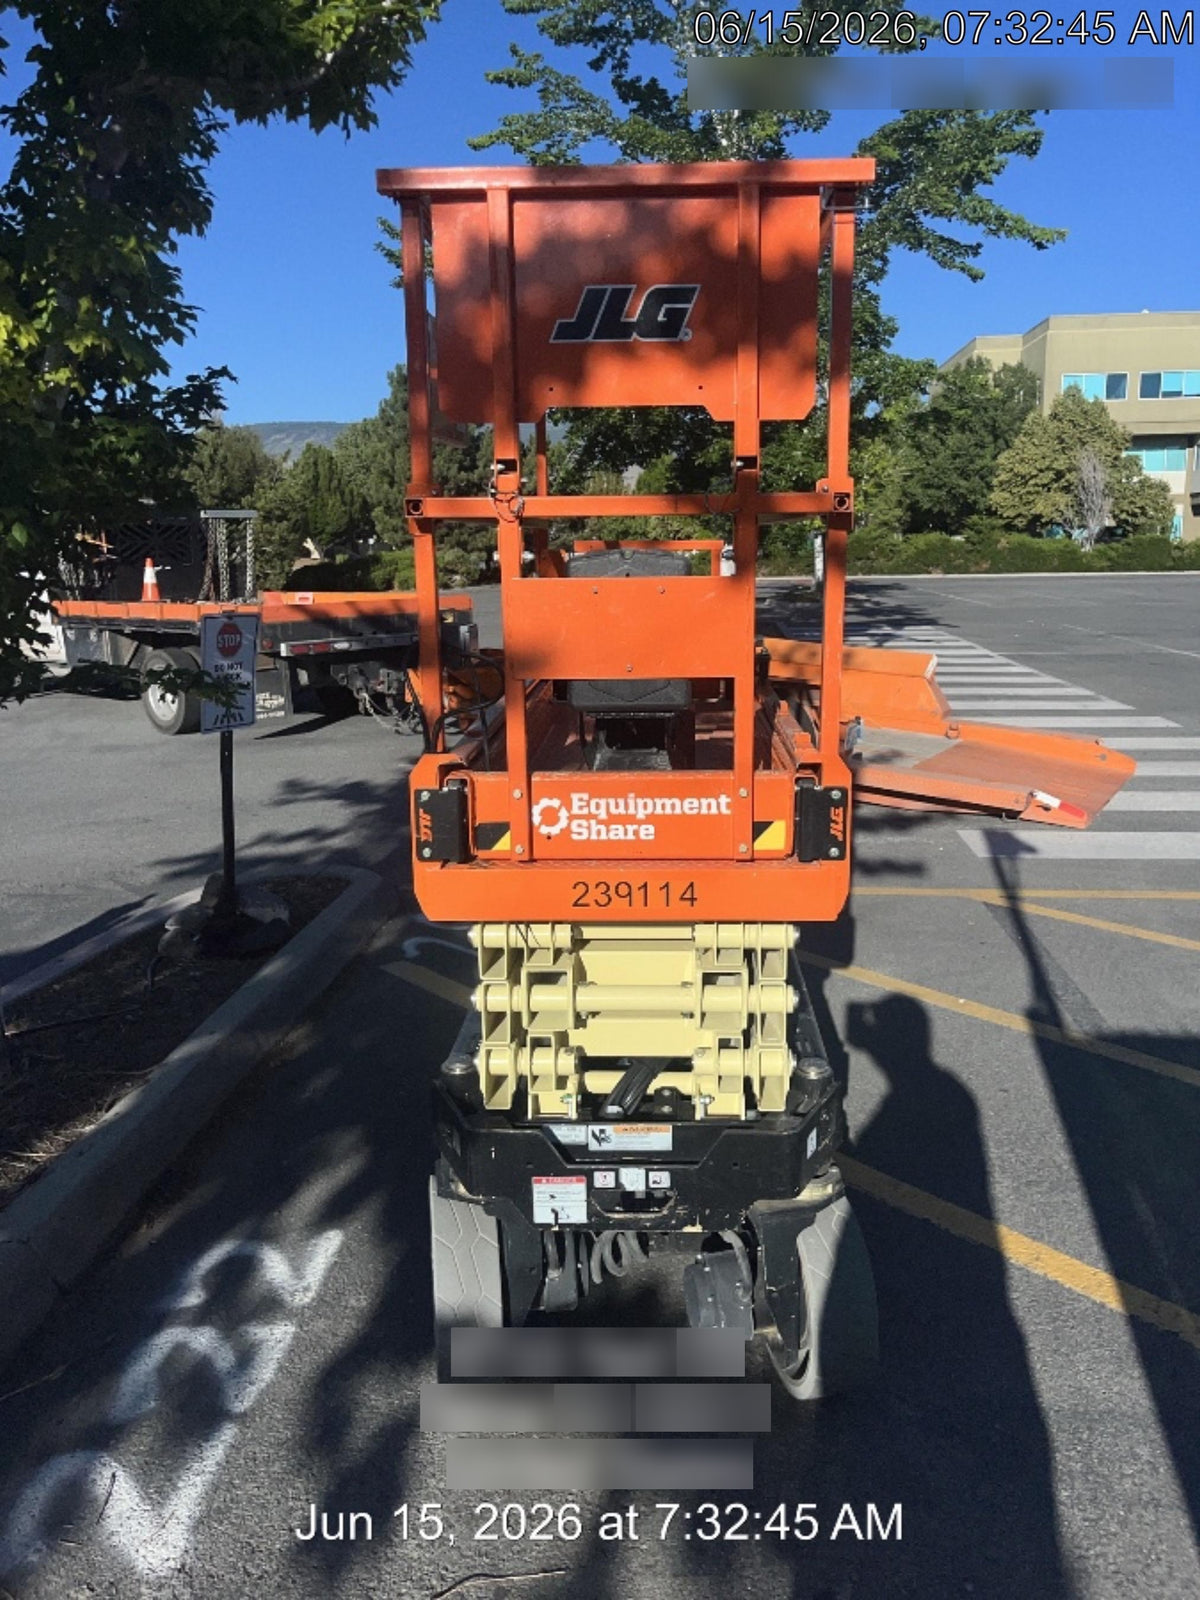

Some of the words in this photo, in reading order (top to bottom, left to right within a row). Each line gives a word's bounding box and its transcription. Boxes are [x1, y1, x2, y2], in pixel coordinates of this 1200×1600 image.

[549, 284, 701, 343] JLG
[217, 633, 242, 648] STOP
[226, 662, 243, 671] NOT
[570, 792, 732, 819] Equipment
[570, 819, 655, 840] Share
[571, 880, 698, 908] 239114
